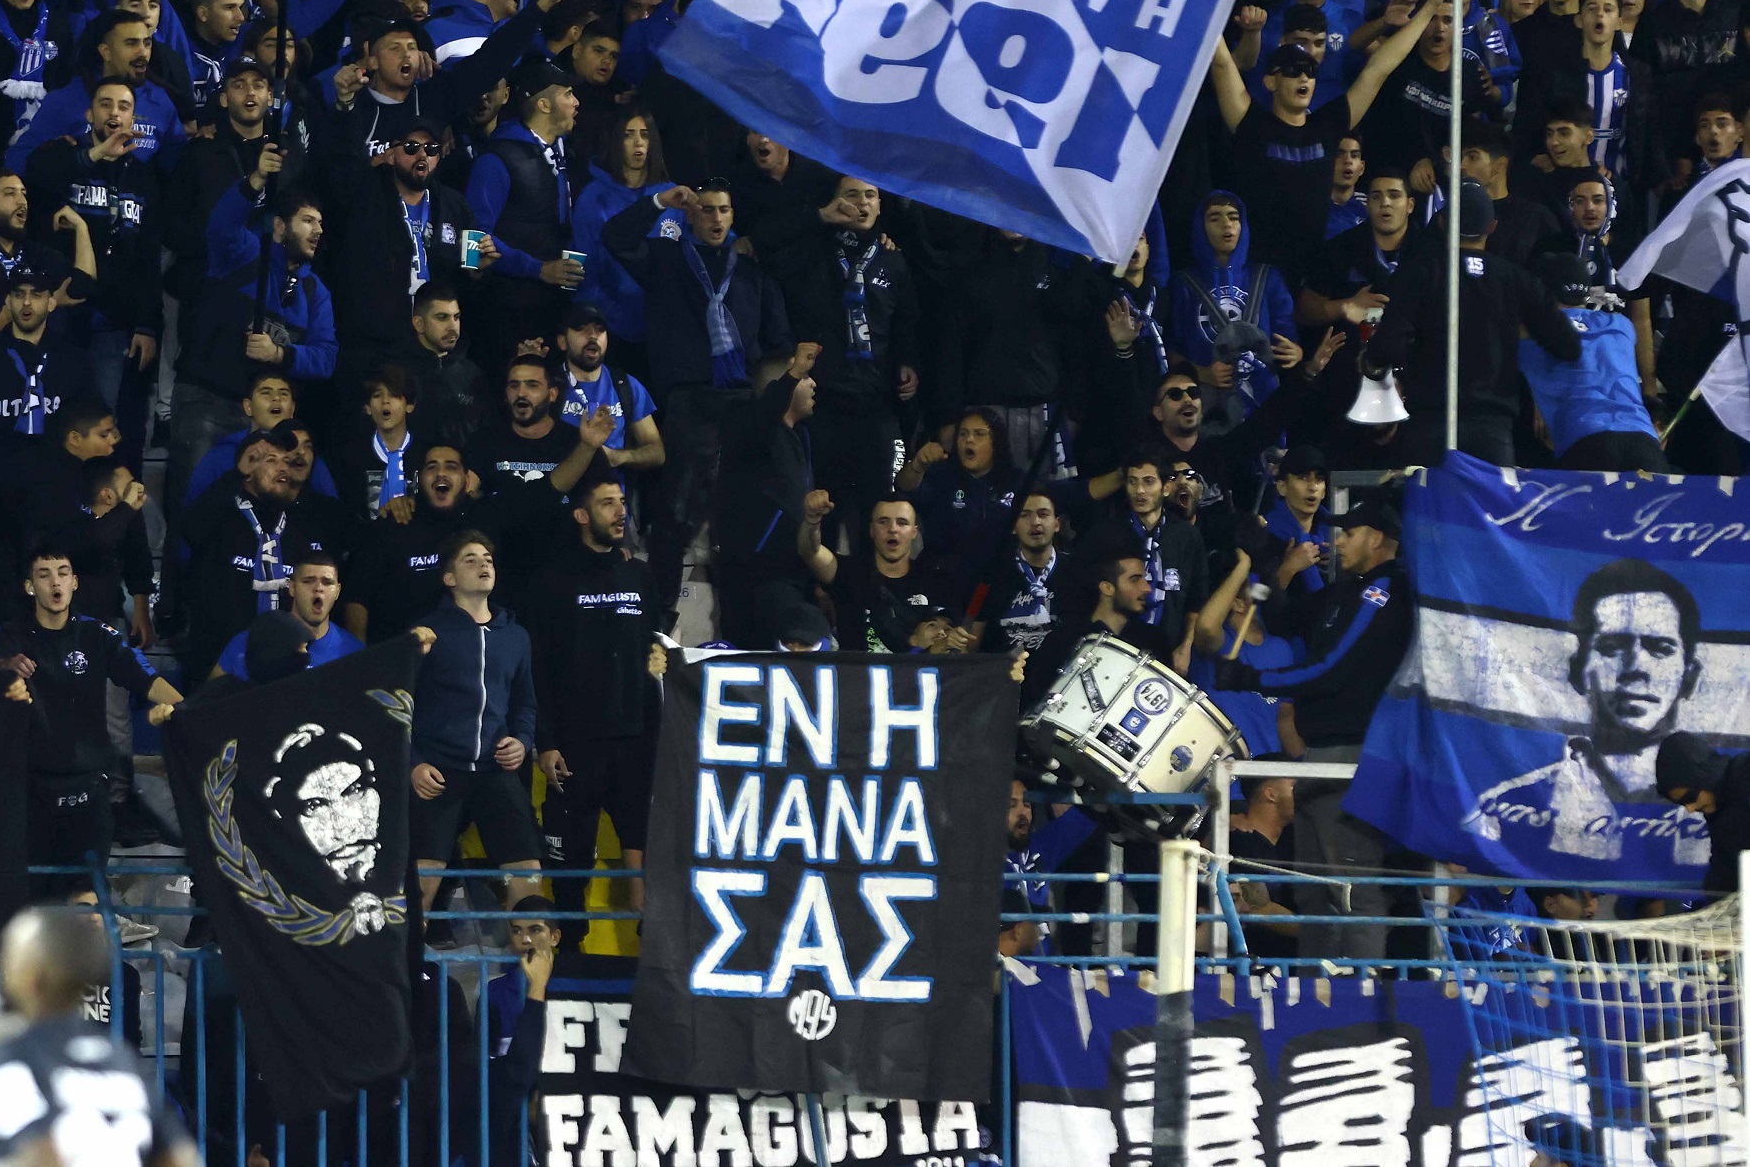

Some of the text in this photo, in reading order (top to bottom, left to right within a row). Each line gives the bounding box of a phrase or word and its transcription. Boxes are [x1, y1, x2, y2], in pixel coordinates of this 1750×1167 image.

[578, 589, 642, 604] FAMAGUSTA
[701, 664, 940, 771] ΕΝ Η
[694, 768, 939, 867] ΜΑΝΑ
[690, 867, 939, 1003] ΣΑΣ
[537, 1092, 982, 1167] FAMAGUSTA
